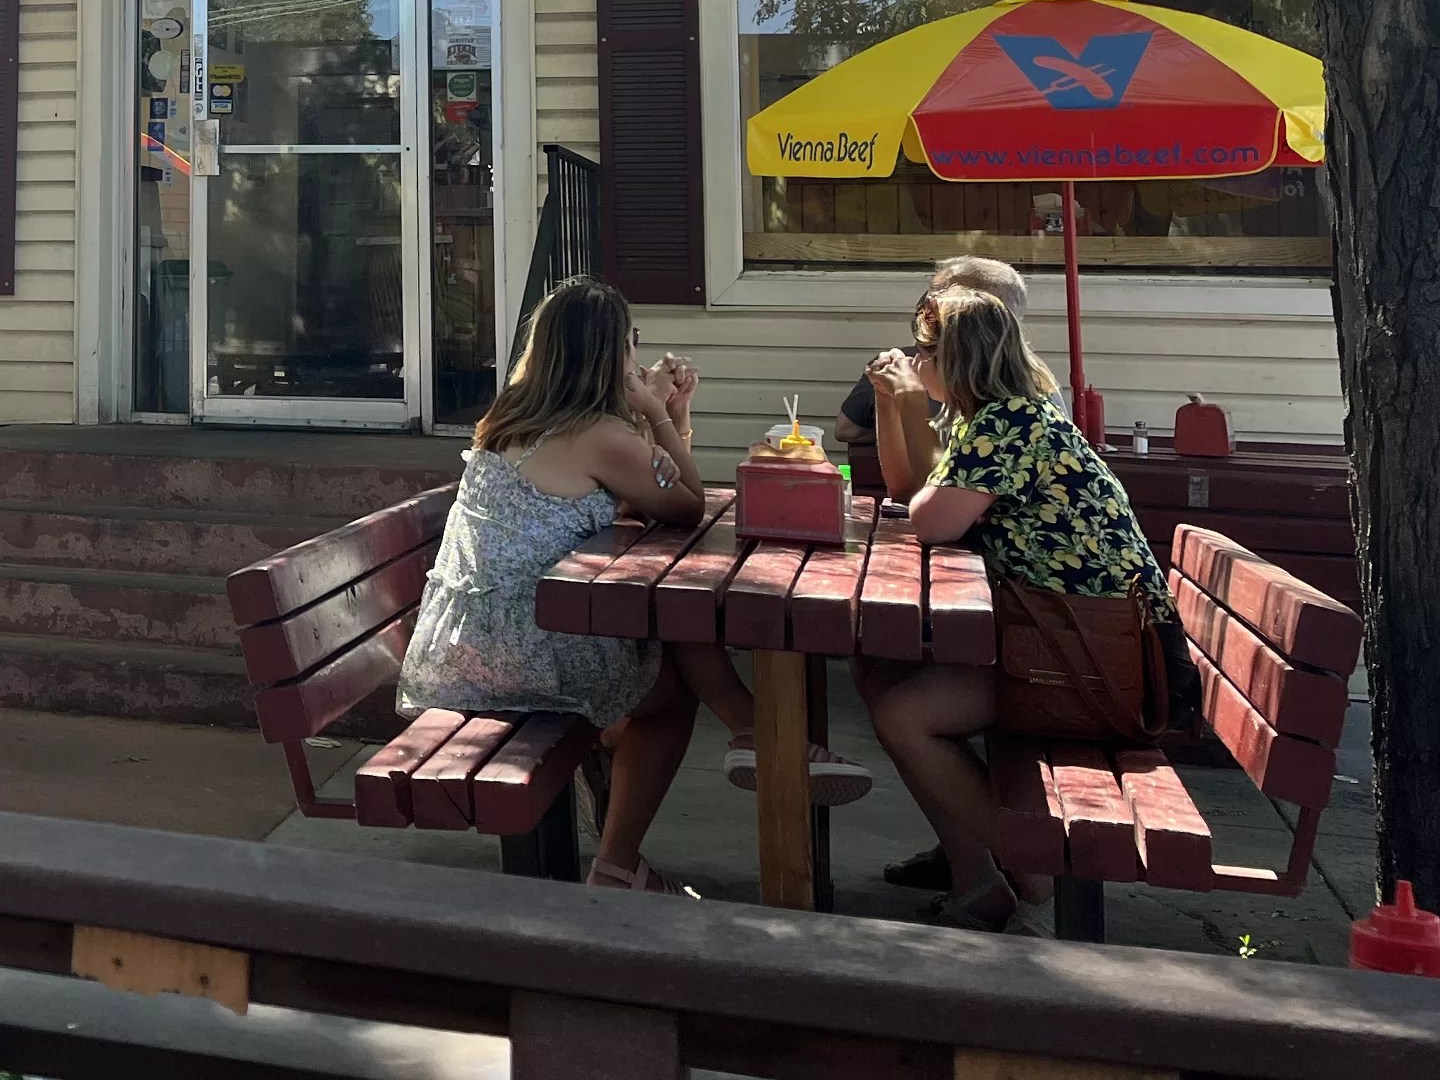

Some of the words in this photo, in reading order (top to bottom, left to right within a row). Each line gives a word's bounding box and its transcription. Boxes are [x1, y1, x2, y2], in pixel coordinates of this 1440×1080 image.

[777, 133, 834, 163] Vienna
[836, 132, 879, 170] Beef
[931, 142, 1259, 167] www.viennabeef.com
